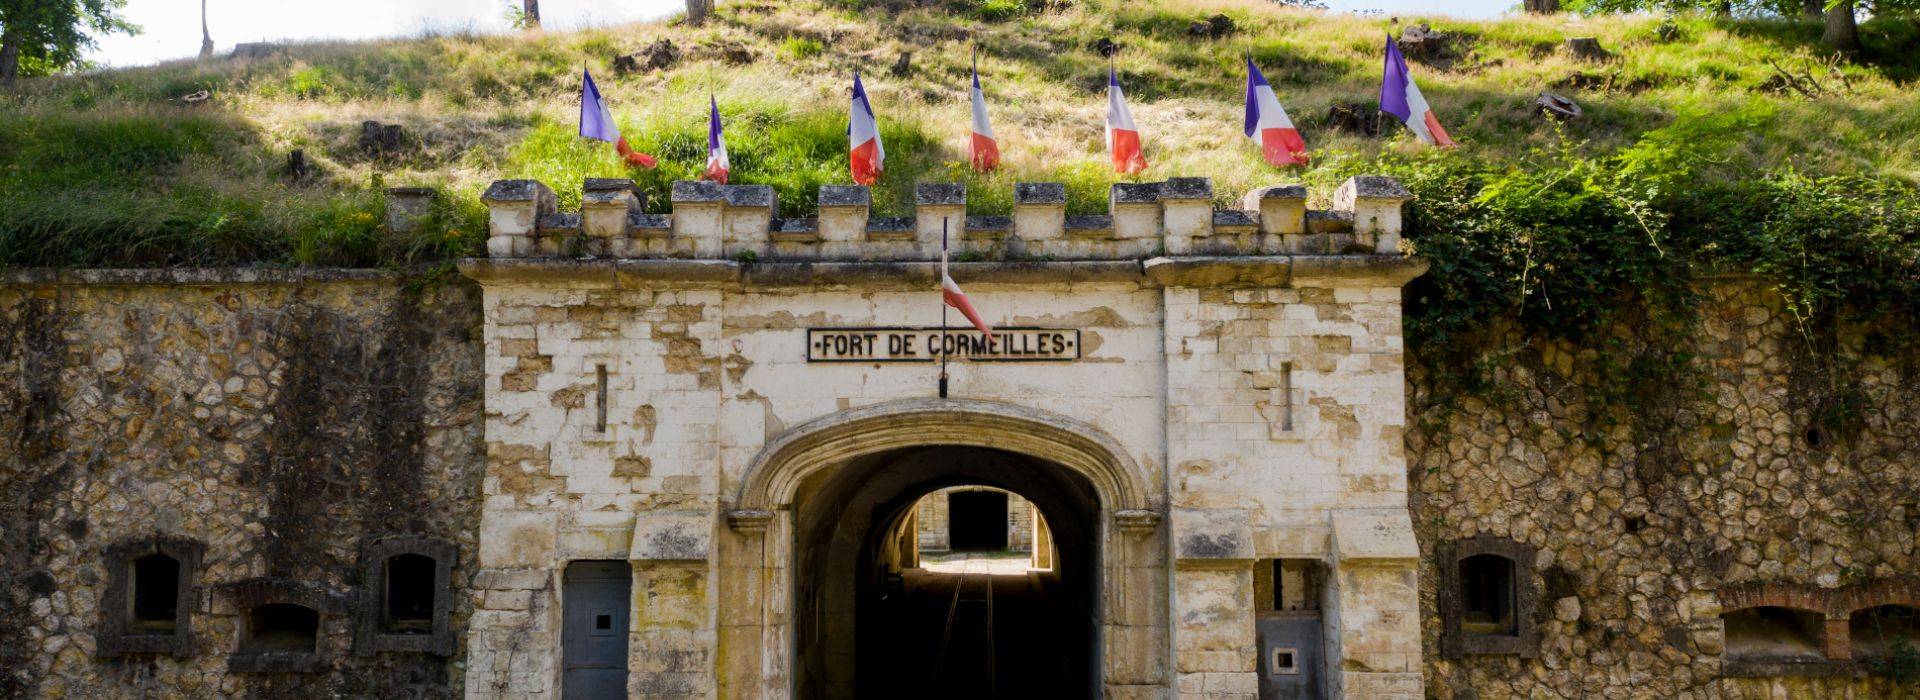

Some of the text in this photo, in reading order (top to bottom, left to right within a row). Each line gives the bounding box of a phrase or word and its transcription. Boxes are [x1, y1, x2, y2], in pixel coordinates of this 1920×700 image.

[822, 333, 1066, 356] FORT DE CORMEILLES
